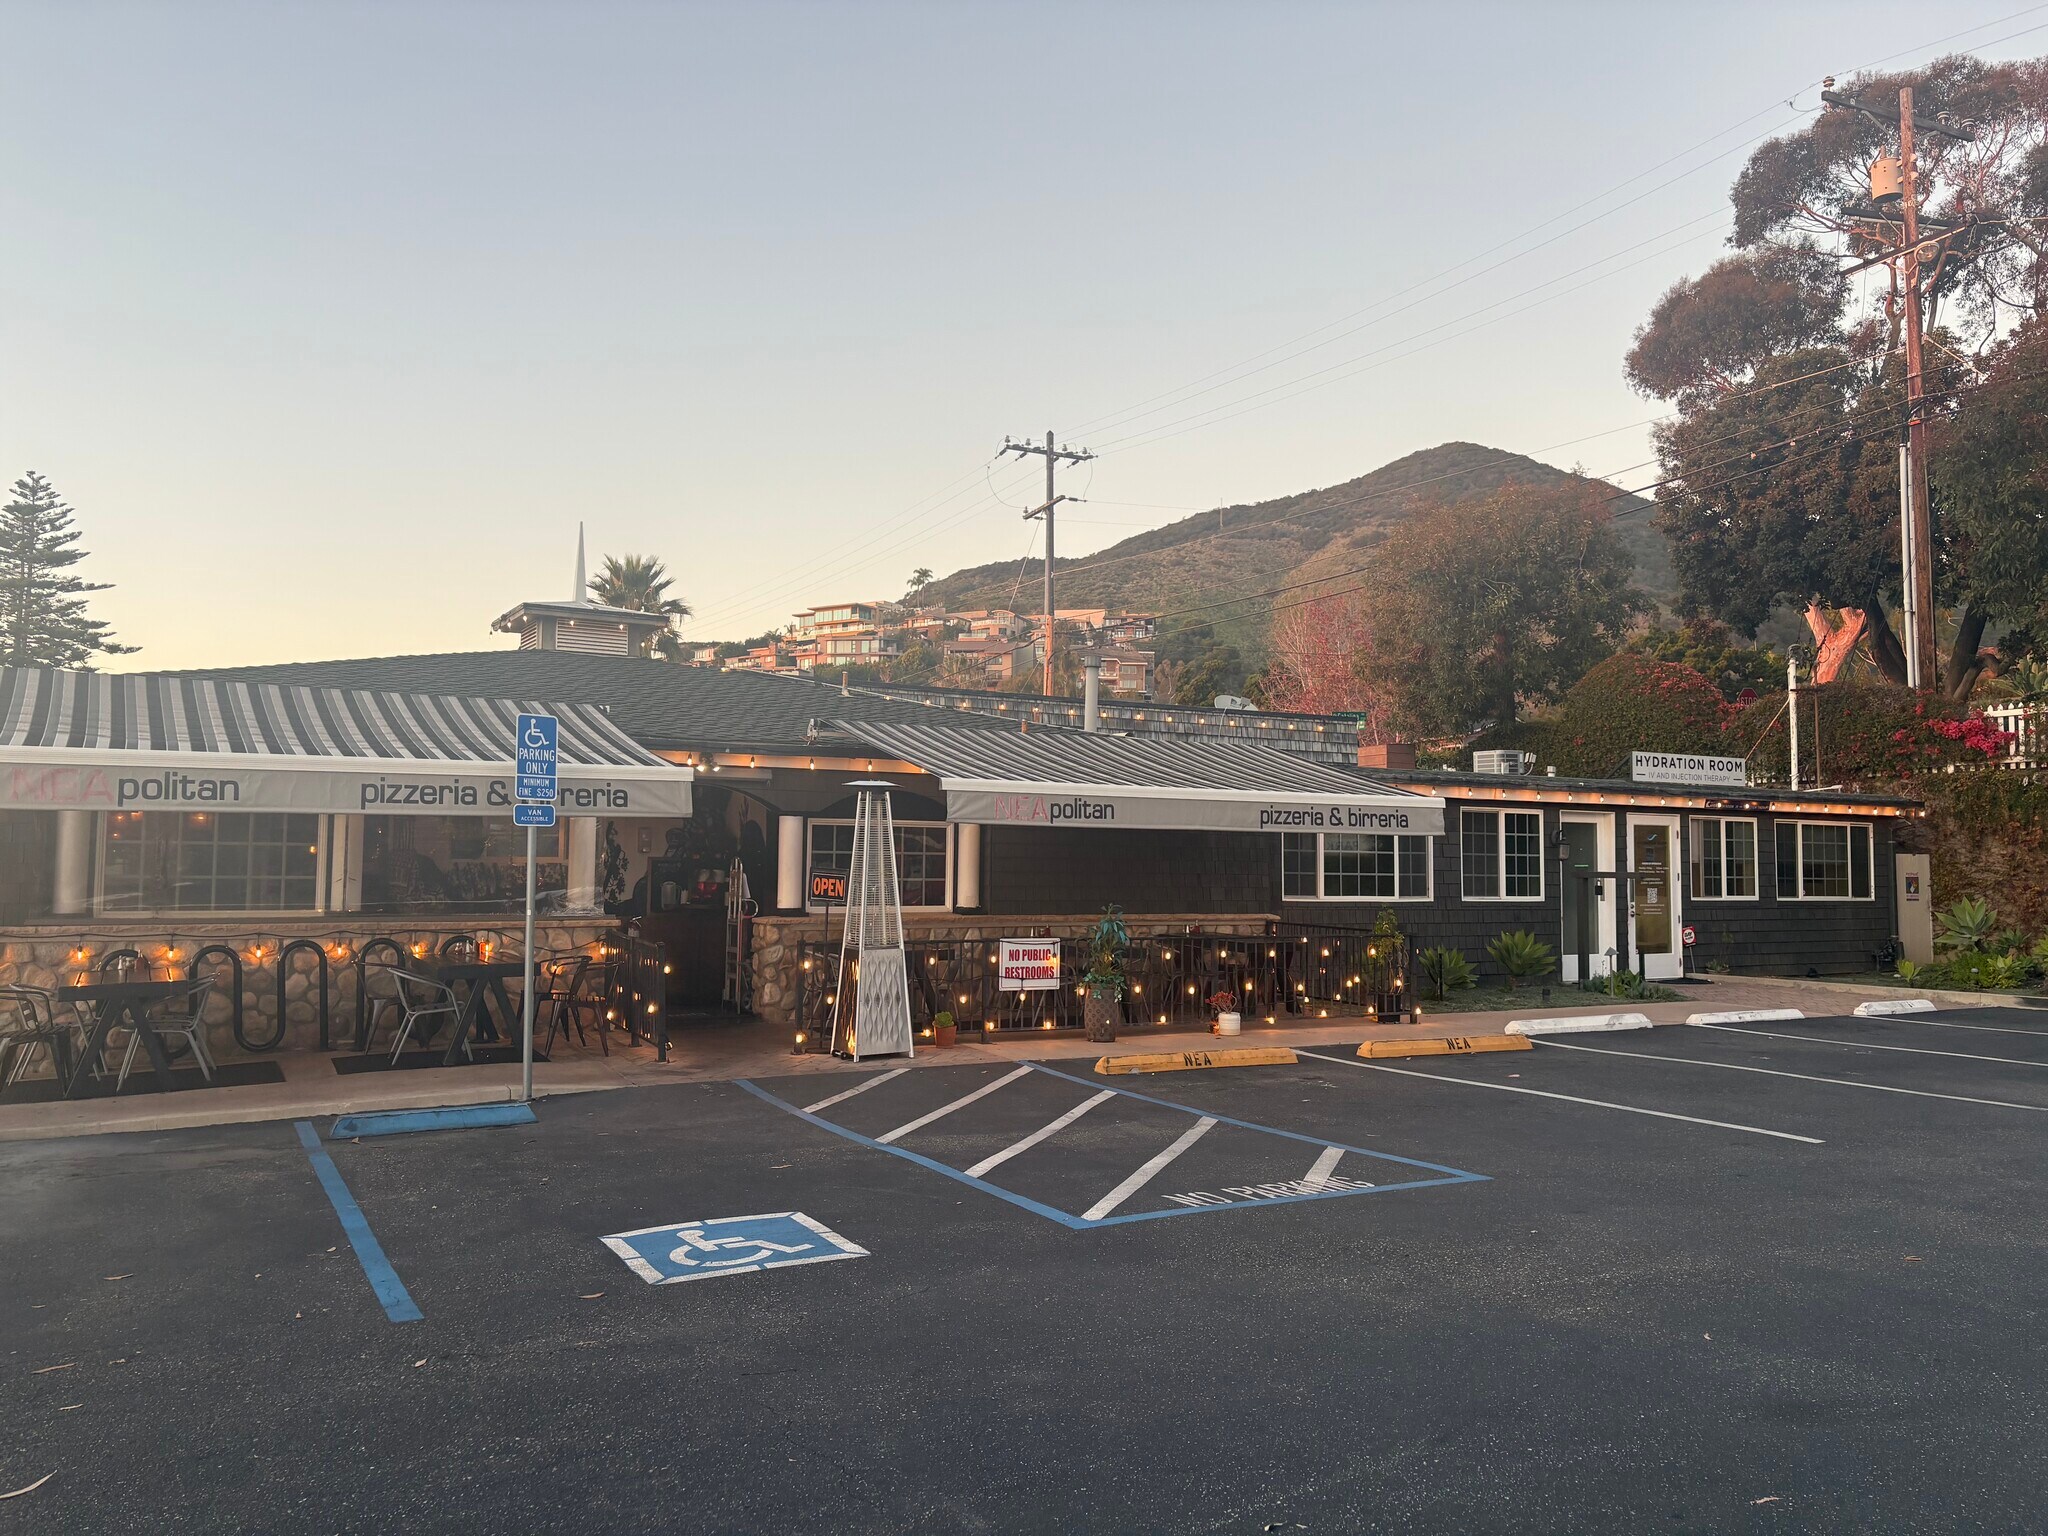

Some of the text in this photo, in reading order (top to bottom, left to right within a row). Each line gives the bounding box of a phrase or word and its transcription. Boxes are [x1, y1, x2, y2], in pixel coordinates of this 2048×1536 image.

[519, 748, 555, 761] PARKING
[525, 762, 548, 774] ONLY
[1635, 755, 1743, 772] HYDRATION ROOM
[523, 777, 550, 788] MINIMUM
[1656, 772, 1670, 780] AND
[1670, 773, 1703, 781] INJECTION
[1703, 774, 1731, 783] THERAPY
[361, 777, 478, 810] pizzeria
[486, 780, 512, 807] &
[518, 787, 554, 798] FINE $250
[527, 809, 542, 817] VAN
[1260, 805, 1409, 829] pizzeria & birreria
[813, 877, 844, 897] OPEN
[1008, 949, 1051, 961] NO PUBLIC
[1005, 966, 1055, 979] RESTROOMS
[1446, 1037, 1471, 1050] NEA
[1183, 1052, 1212, 1066] NEA
[1161, 1191, 1233, 1208] NO
